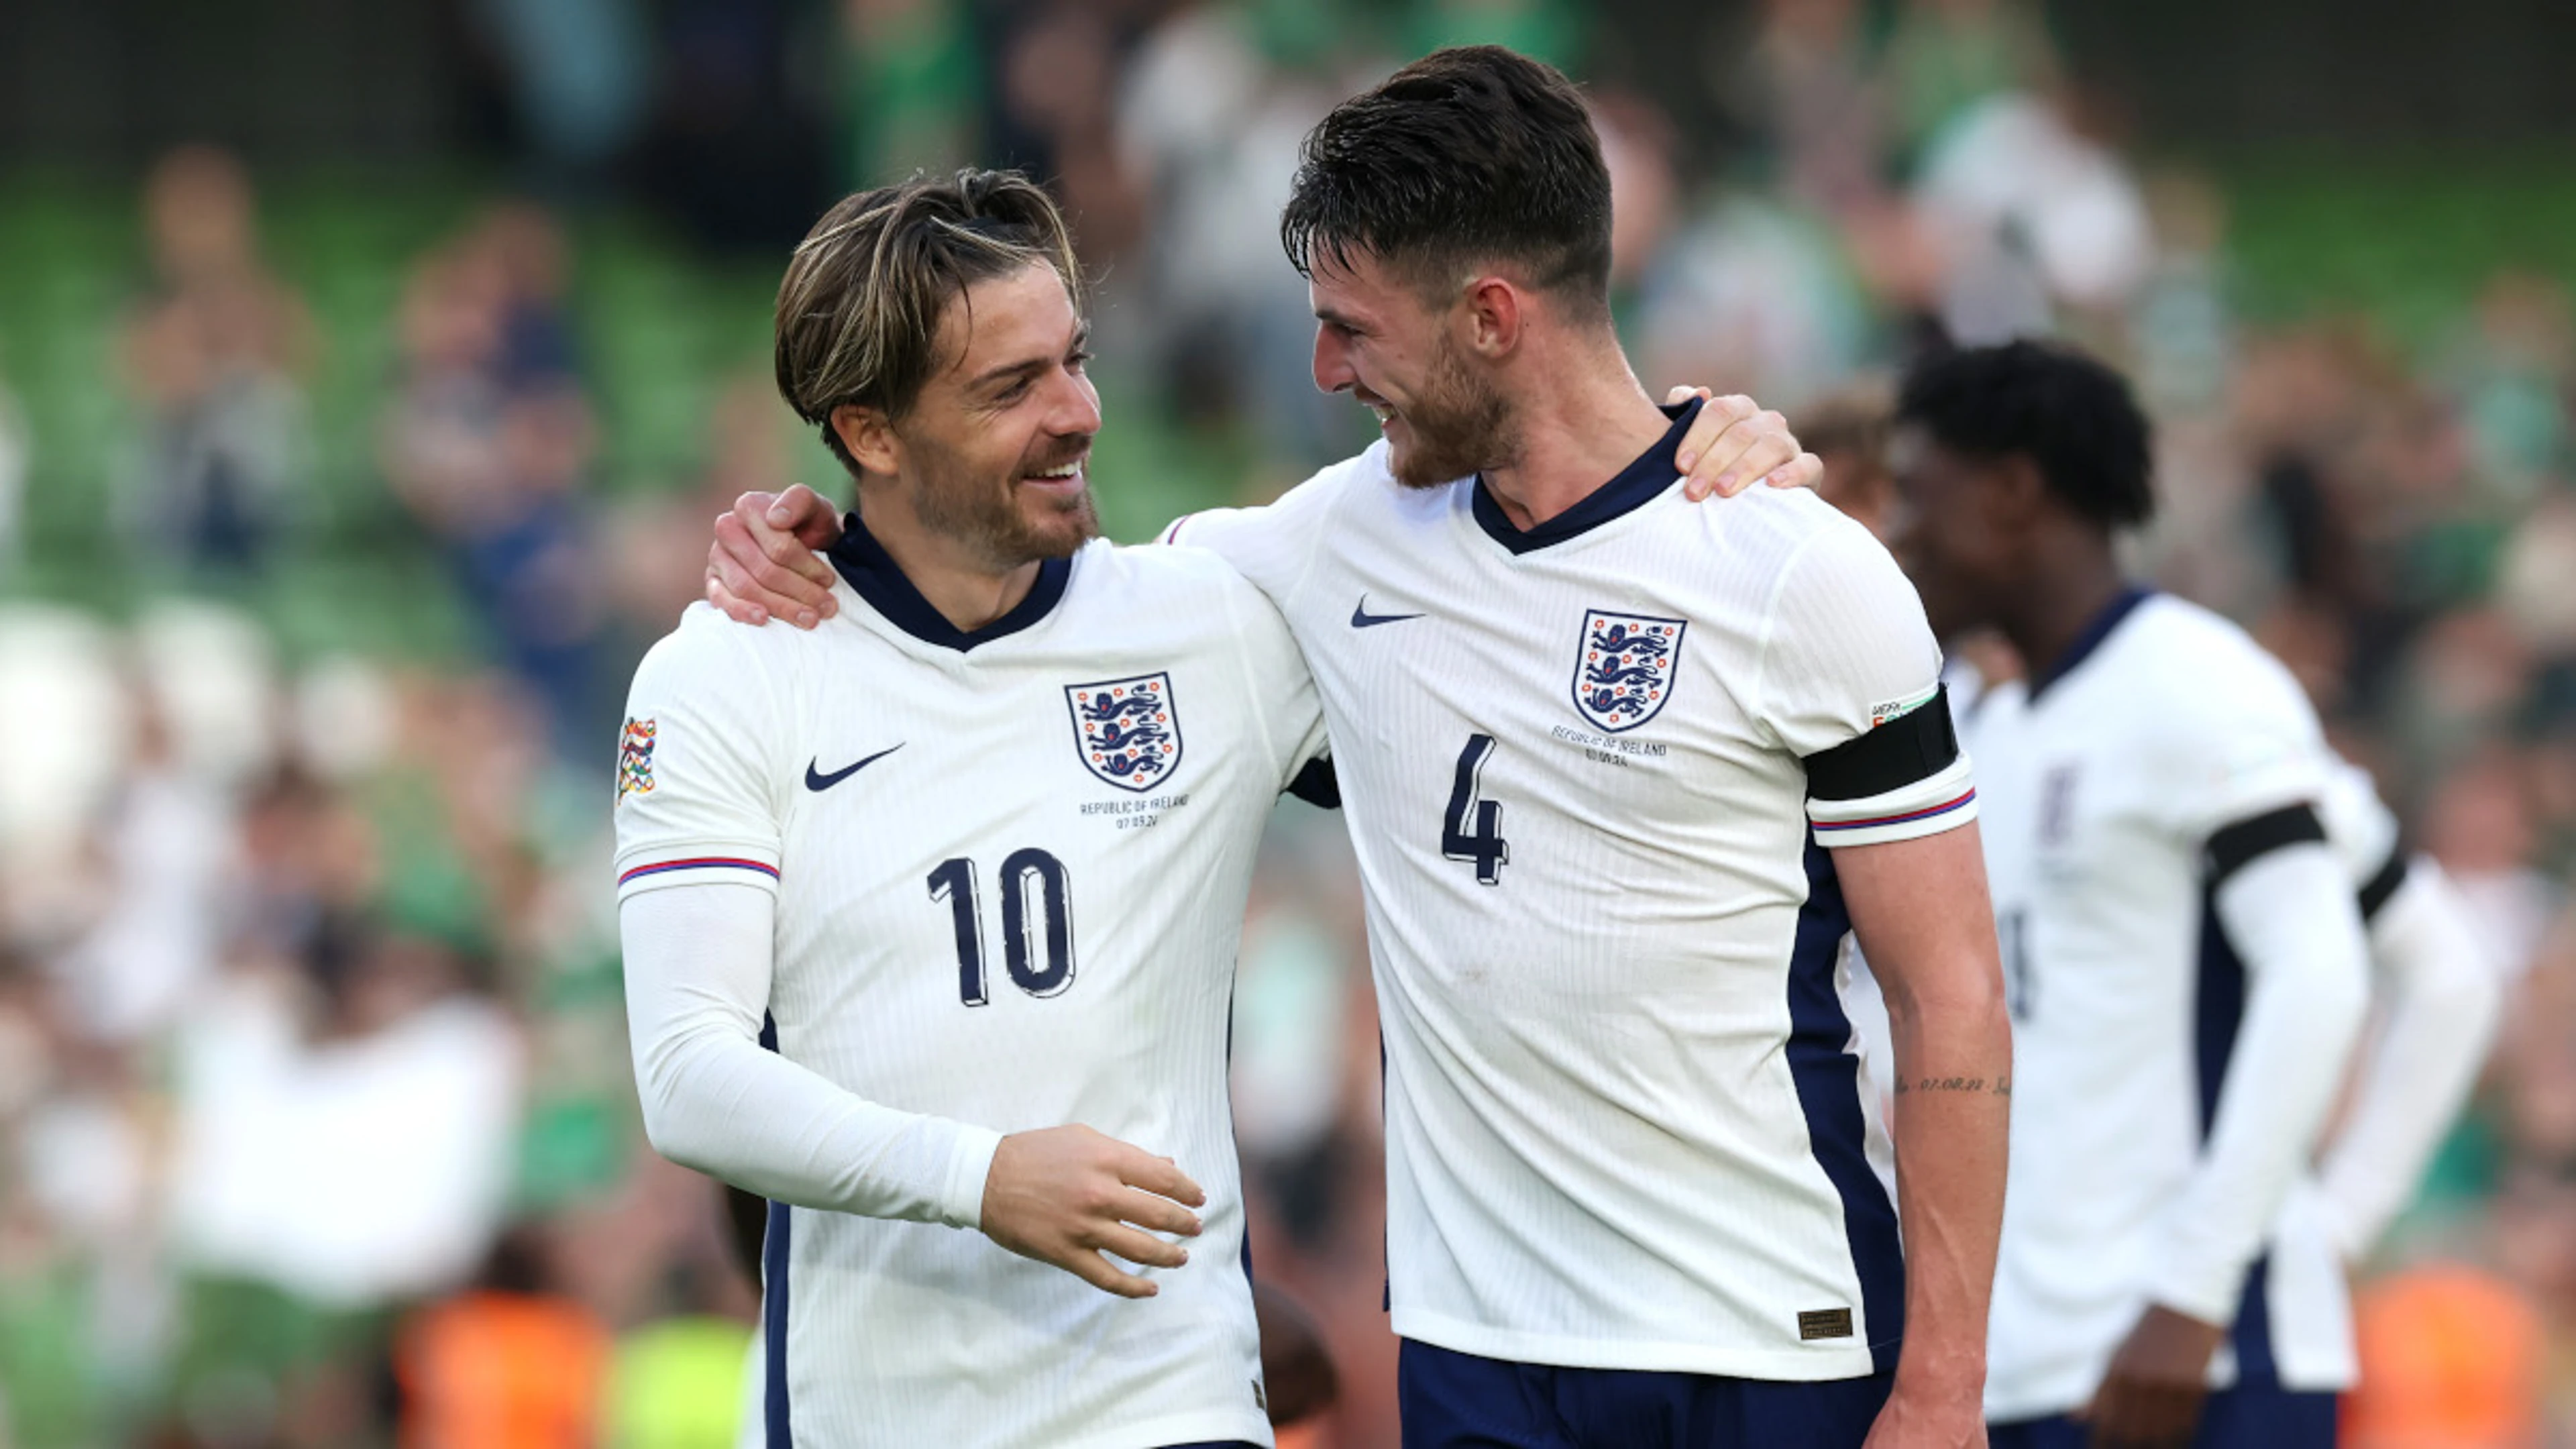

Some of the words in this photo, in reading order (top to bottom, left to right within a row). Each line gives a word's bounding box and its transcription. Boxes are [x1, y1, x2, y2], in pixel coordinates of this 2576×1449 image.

[1552, 725, 1602, 745] REPUBLIC
[1603, 739, 1616, 748] OF
[1618, 741, 1666, 756] IRELAND
[1080, 800, 1132, 815] REPUBLIC
[1134, 800, 1146, 812] OF
[1150, 794, 1189, 809] IRELAND
[1442, 734, 1509, 885] 4
[927, 847, 1076, 1007] 10
